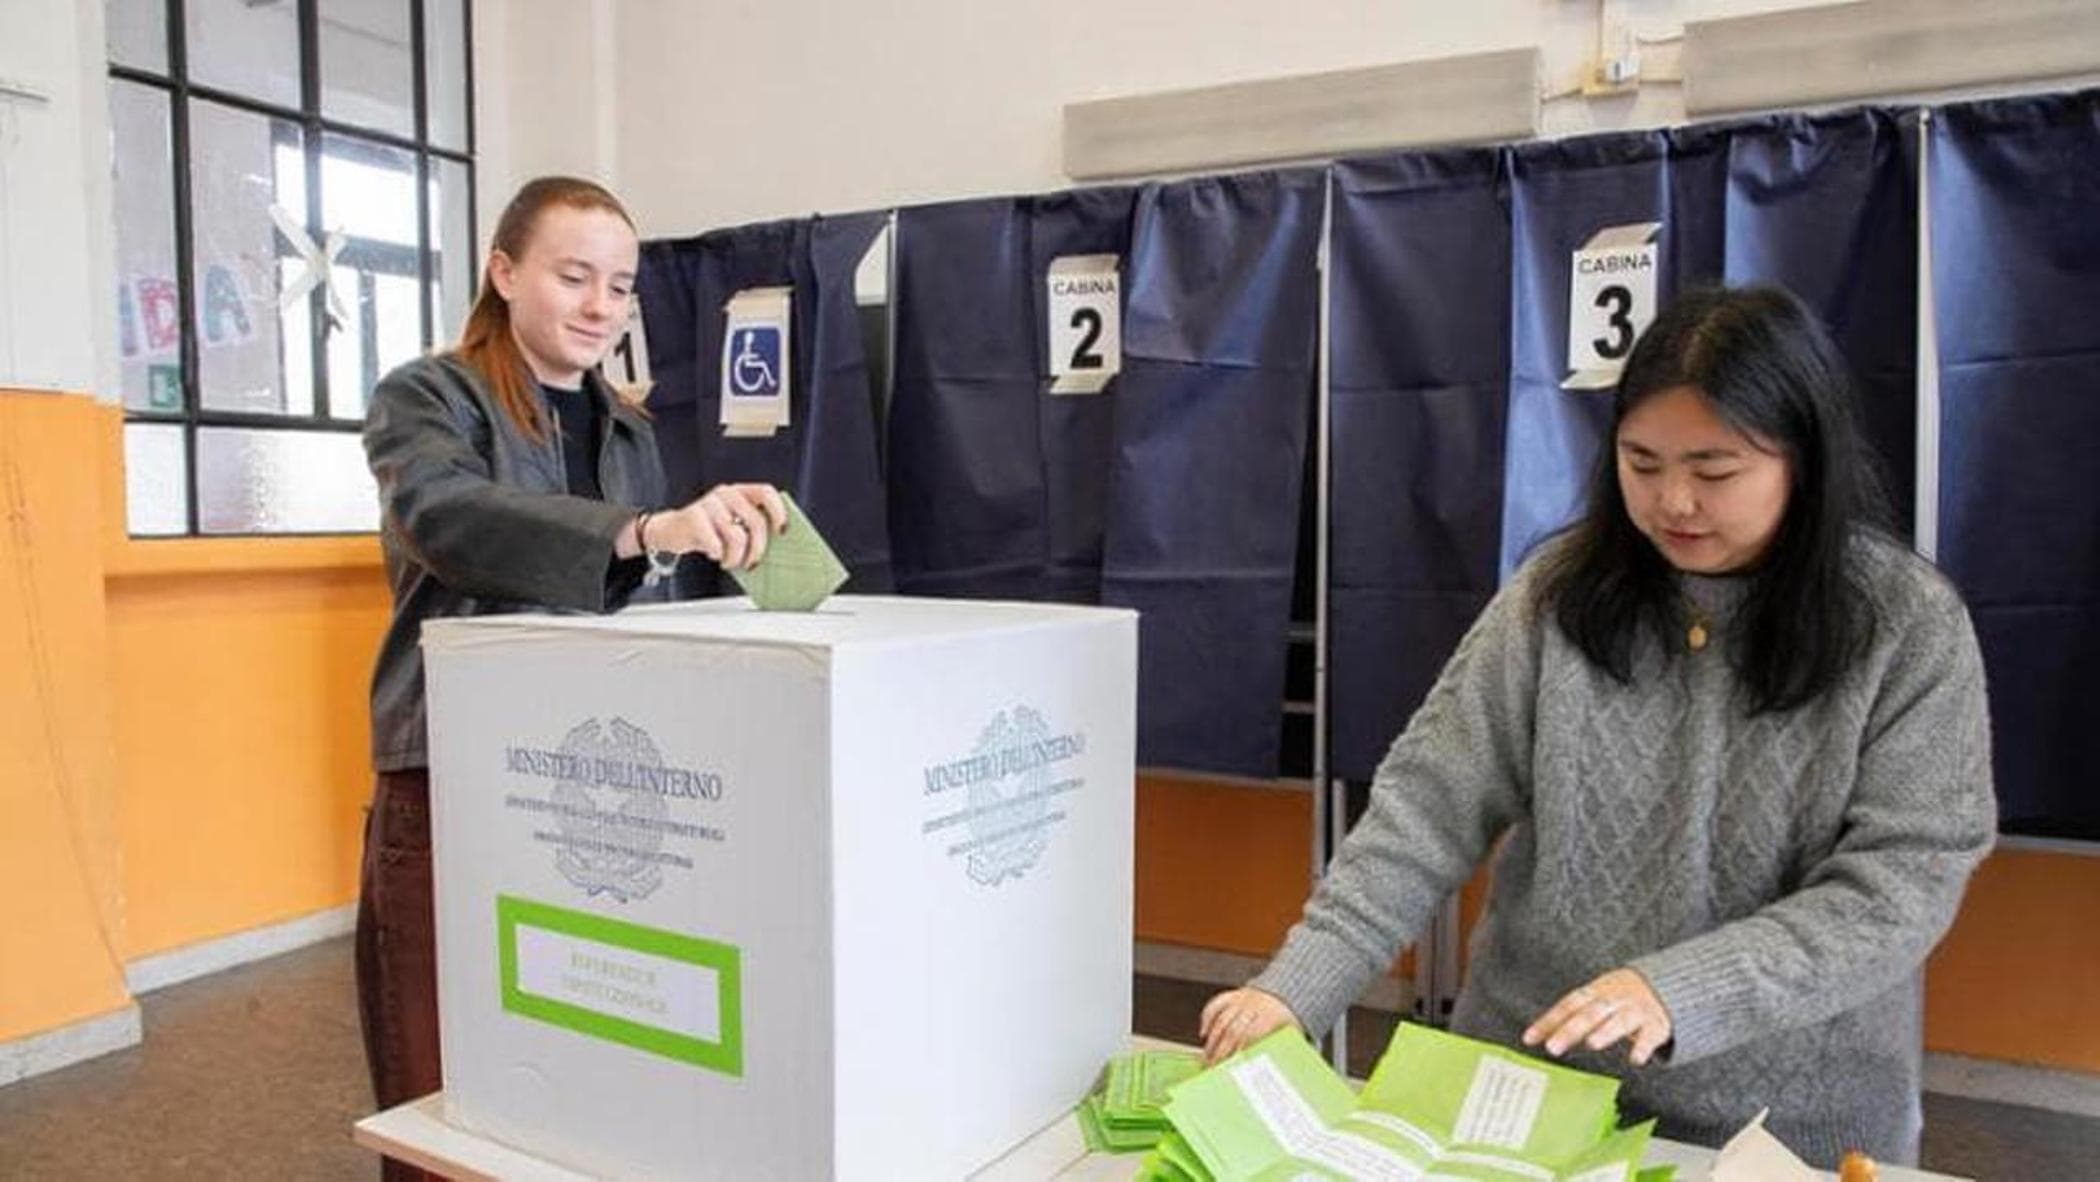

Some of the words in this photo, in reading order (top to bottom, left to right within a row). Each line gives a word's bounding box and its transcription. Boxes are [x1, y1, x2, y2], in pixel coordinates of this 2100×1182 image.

[1579, 254, 1651, 274] CABINA
[1053, 279, 1116, 295] CABINA
[1070, 307, 1103, 369] 2
[1593, 285, 1634, 359] 3
[614, 332, 636, 382] 1
[506, 747, 593, 788] MINISTERO
